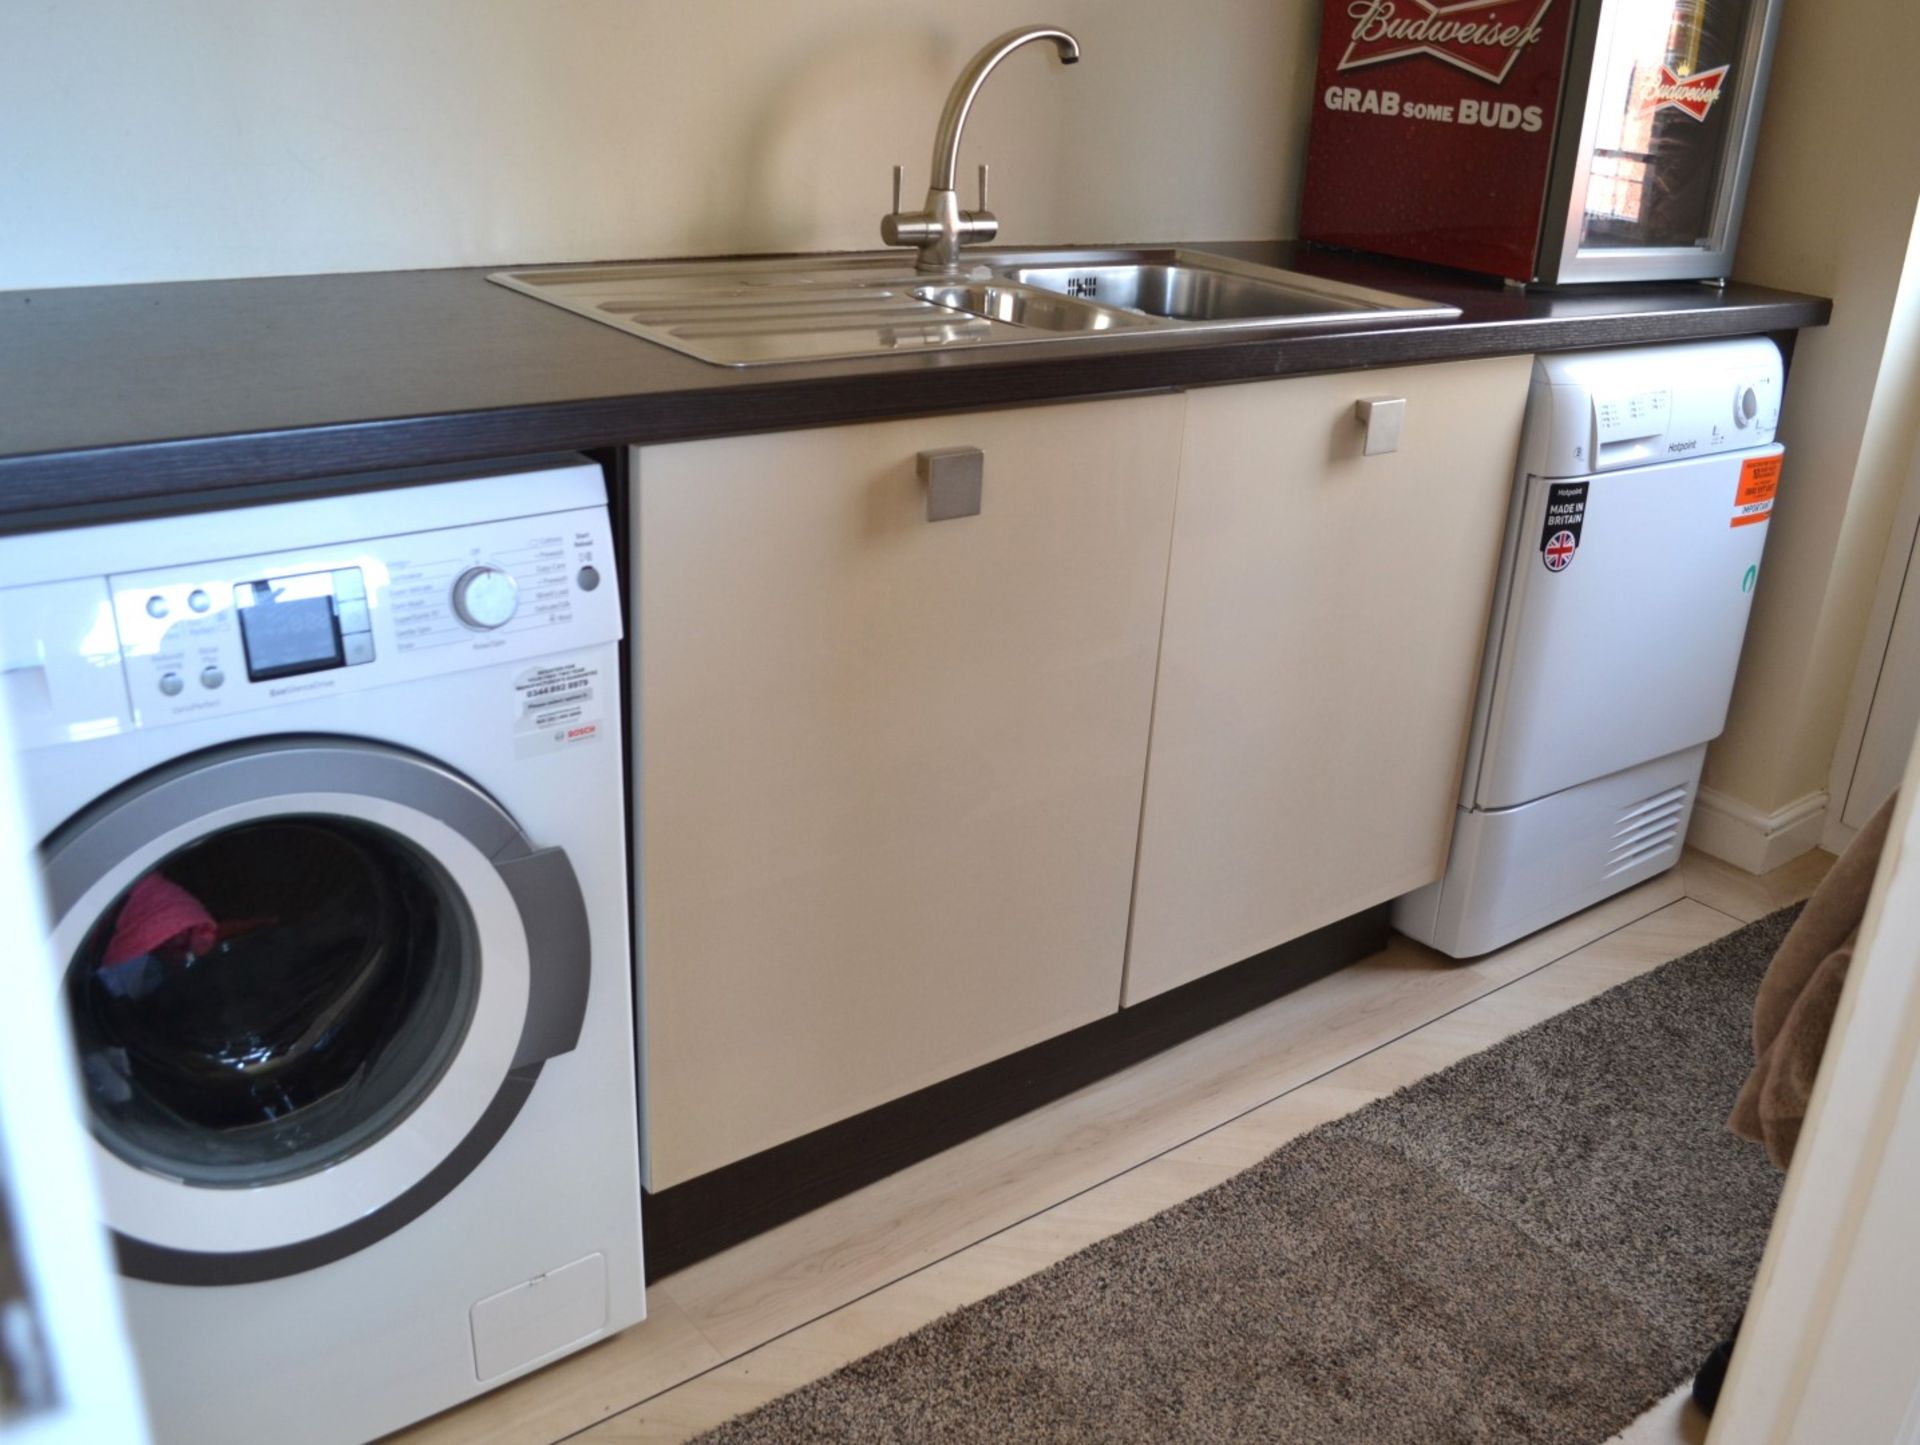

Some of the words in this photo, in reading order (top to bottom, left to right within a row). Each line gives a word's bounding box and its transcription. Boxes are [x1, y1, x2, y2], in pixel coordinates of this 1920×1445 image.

[1347, 0, 1542, 48] Budweiser
[1640, 74, 1721, 104] Budweiser
[1324, 86, 1401, 116] GRAB
[1402, 102, 1454, 123] SOME
[1457, 99, 1543, 132] BUDS
[1668, 440, 1697, 453] Hotpoint
[1558, 487, 1583, 497] Hotpoint
[1550, 503, 1575, 514] MADE
[1575, 502, 1584, 512] IN
[1548, 513, 1582, 526] BRITAIN
[567, 725, 596, 738] BOSCH
